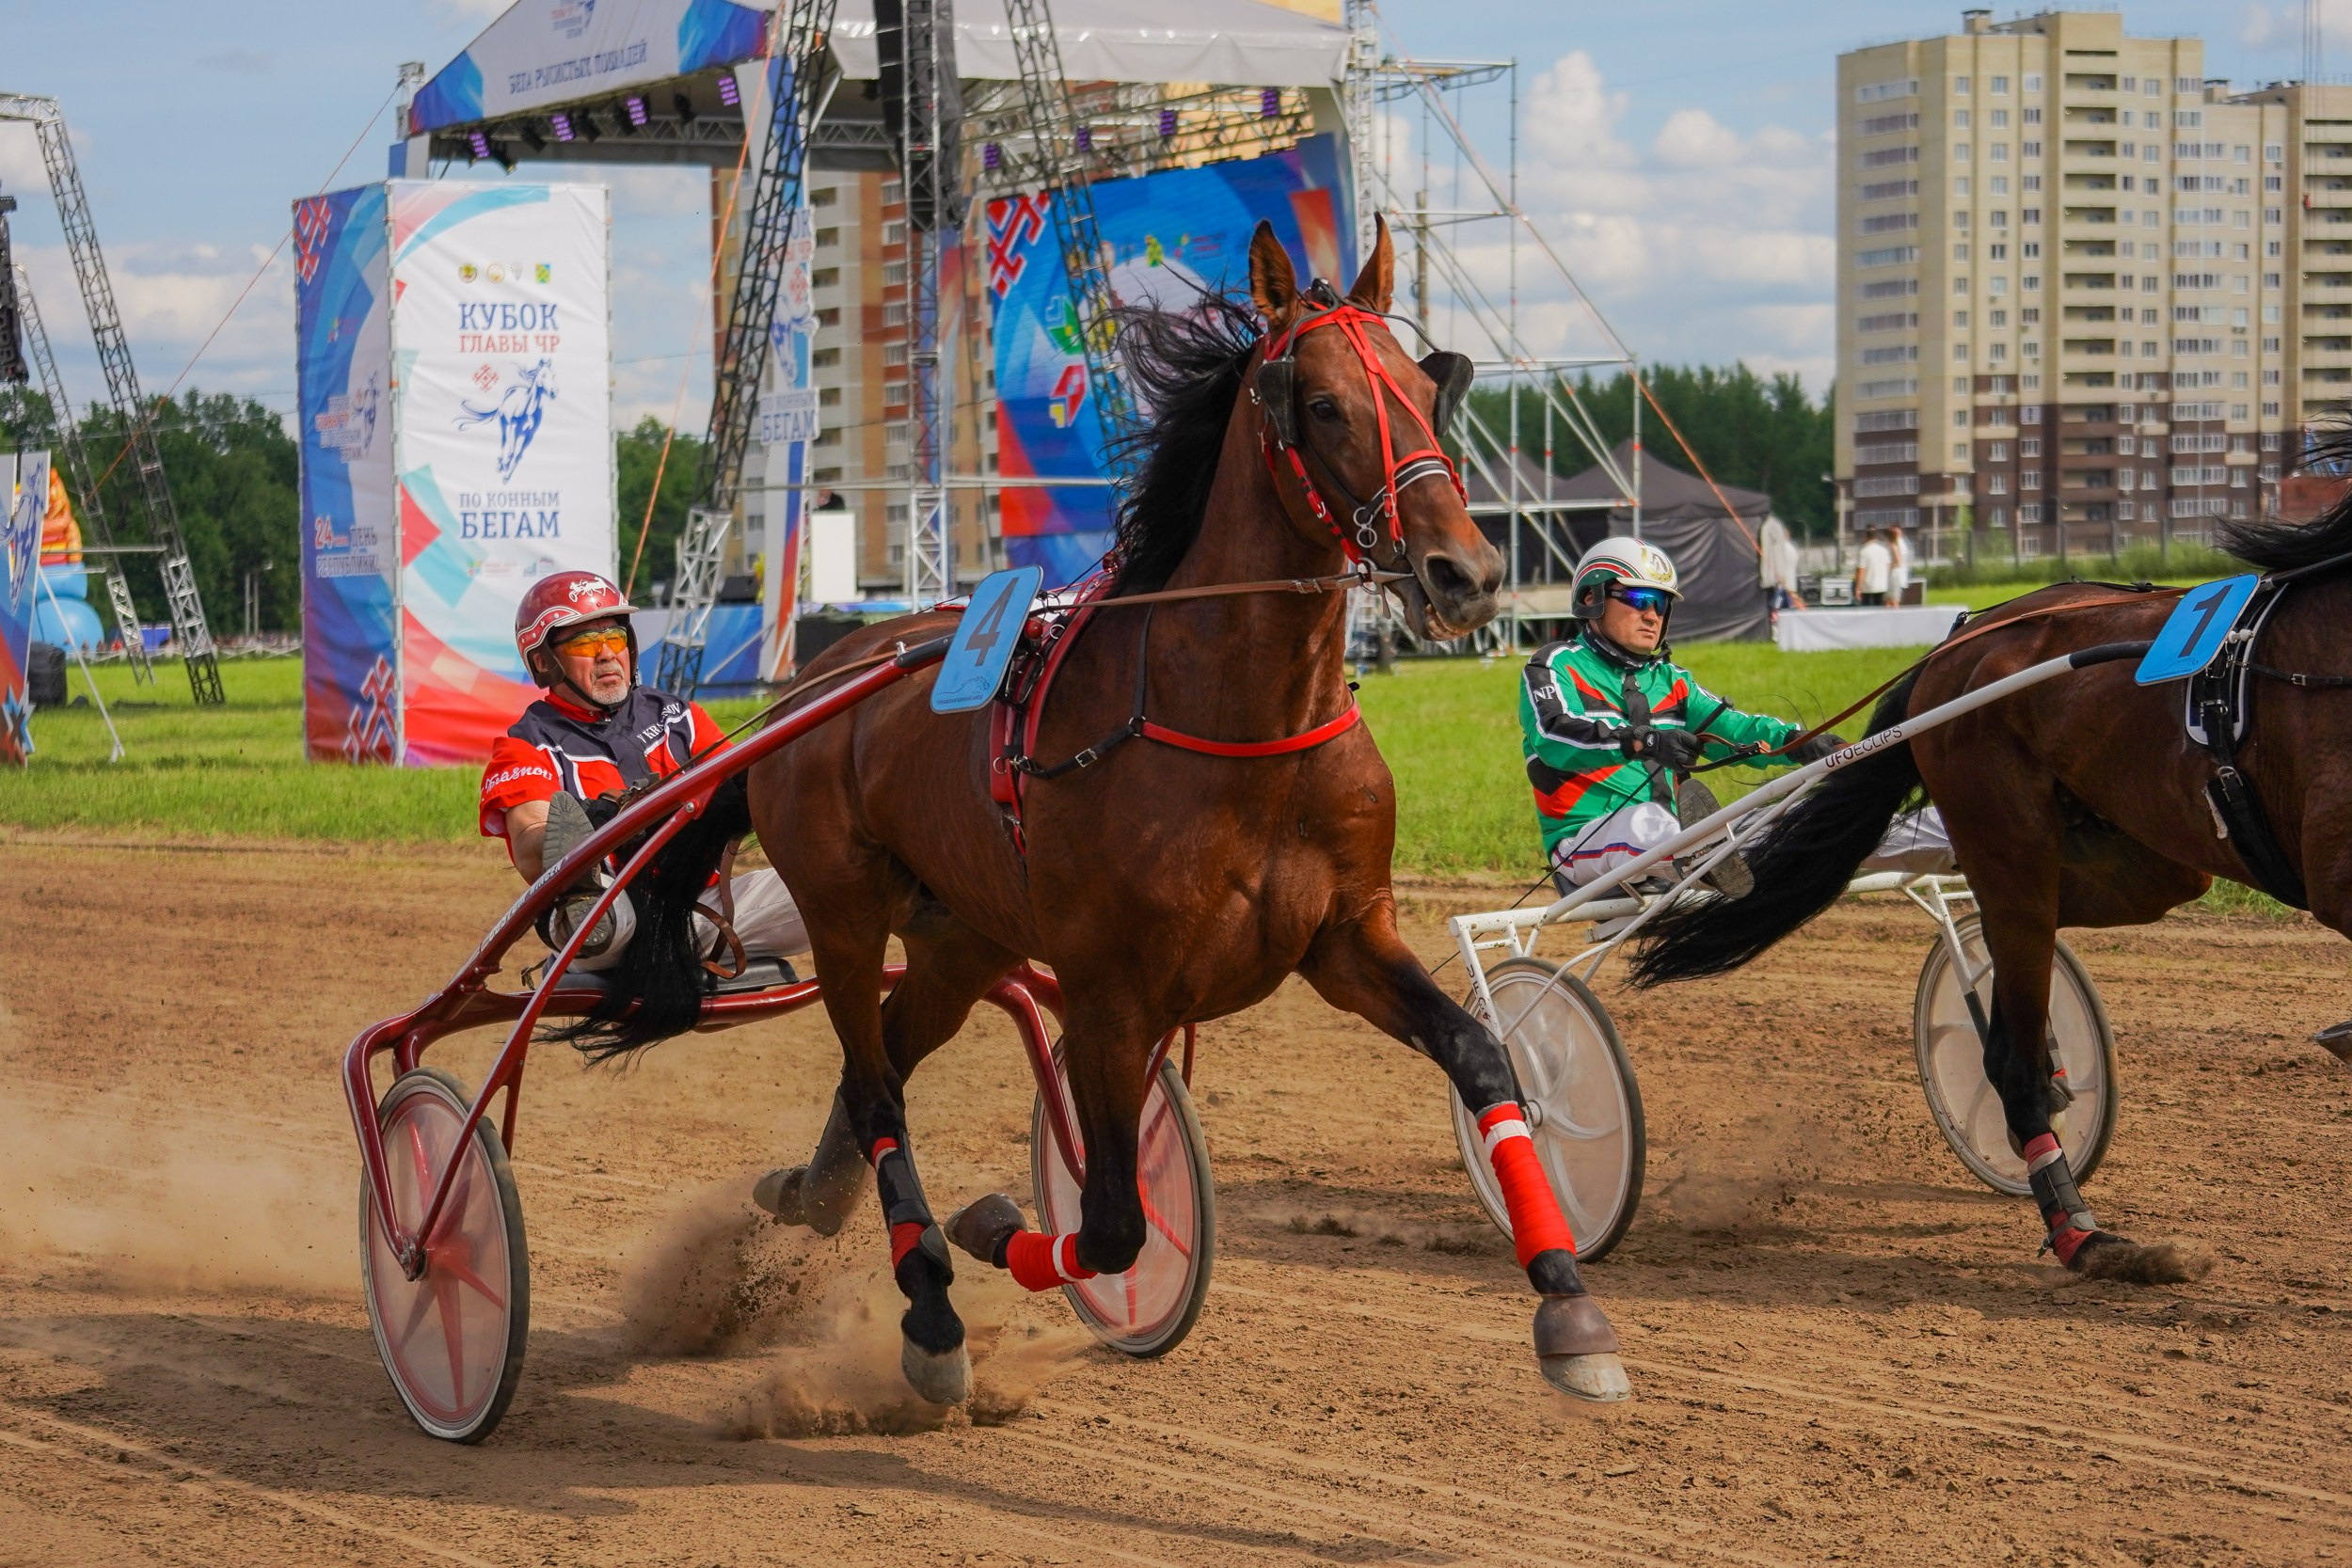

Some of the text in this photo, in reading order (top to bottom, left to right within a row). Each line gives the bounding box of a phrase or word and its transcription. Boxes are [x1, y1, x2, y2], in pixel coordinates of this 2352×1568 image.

[458, 303, 559, 330] КУБОК
[459, 334, 561, 354] ГЛАВЫ ЧР
[762, 409, 815, 442] БЕГАМ
[459, 491, 560, 508] ПО КОННЫМ
[315, 517, 332, 548] 24
[351, 528, 377, 550] ДЕНЬ
[460, 511, 561, 540] БЕГАМ
[964, 577, 1020, 667] 4
[2178, 584, 2234, 657] 1
[1533, 686, 1555, 704] NP
